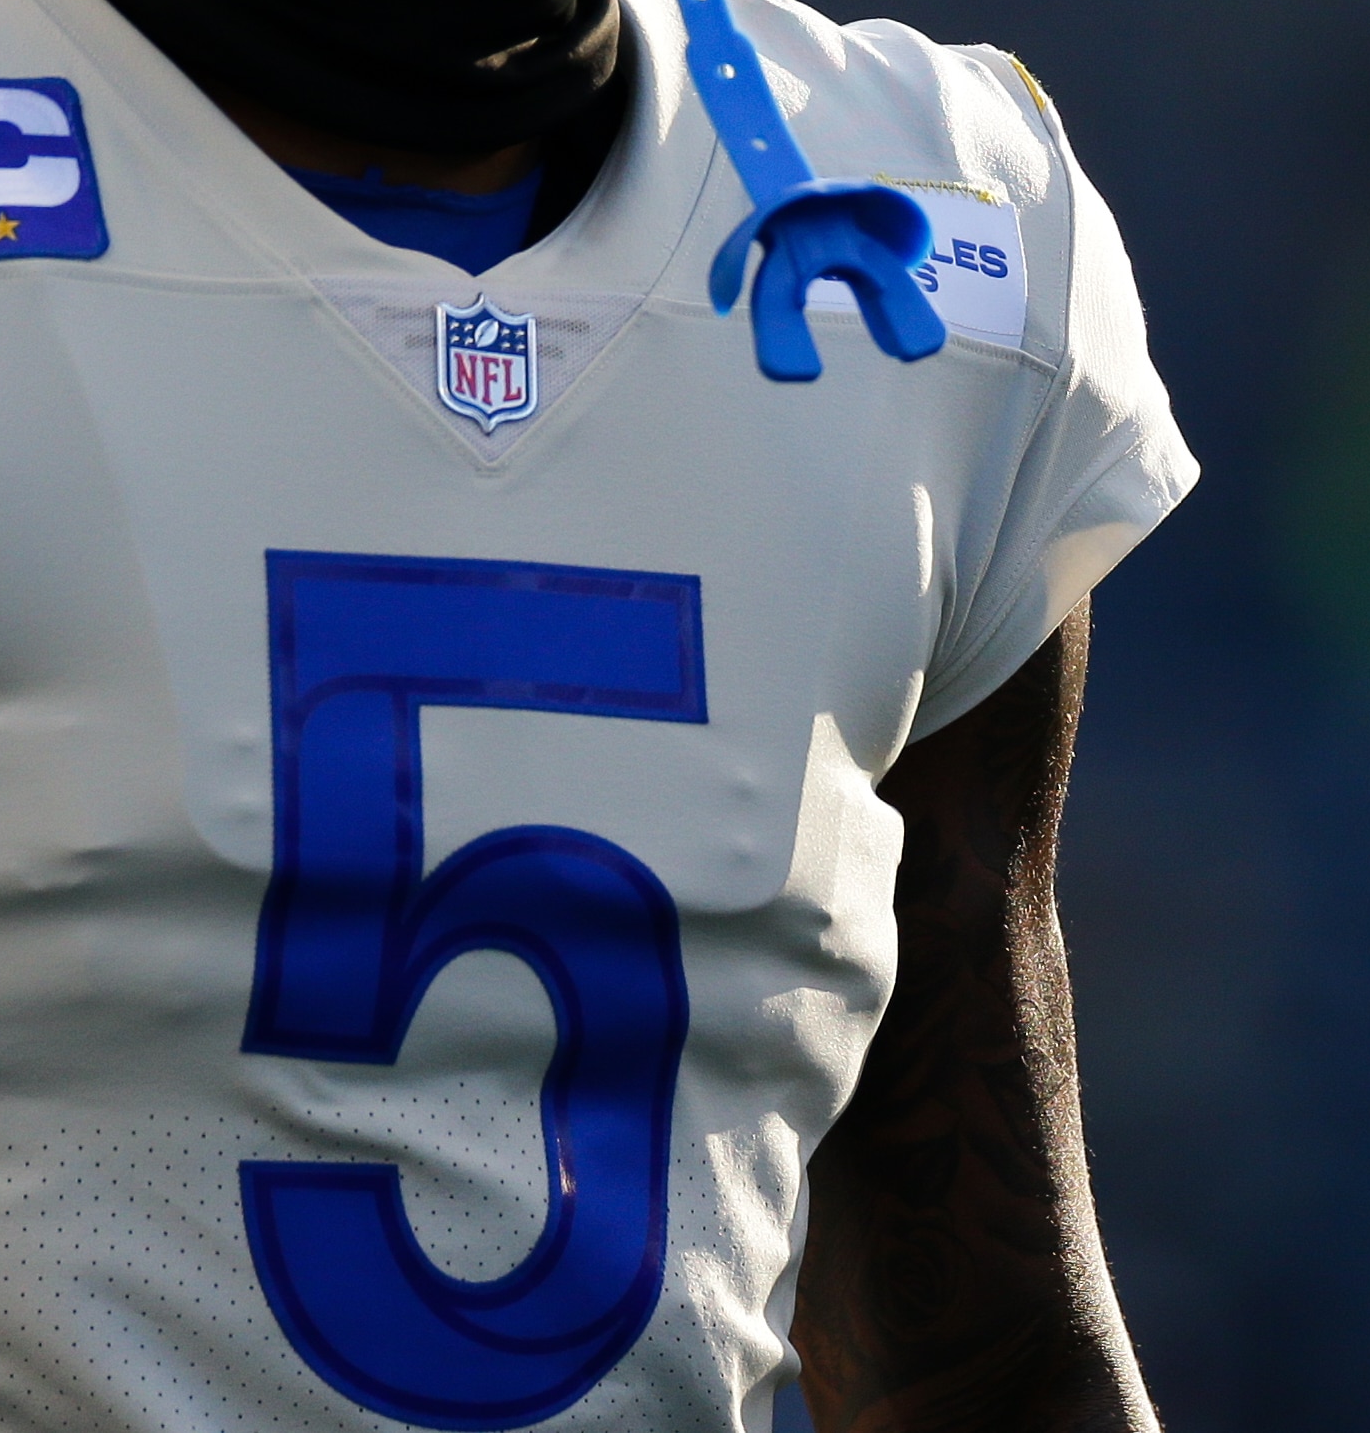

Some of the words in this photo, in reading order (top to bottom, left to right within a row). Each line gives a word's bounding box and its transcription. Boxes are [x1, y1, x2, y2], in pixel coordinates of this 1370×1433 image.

[929, 237, 1009, 279] LES
[454, 352, 522, 406] NFL
[238, 548, 710, 1431] 5
